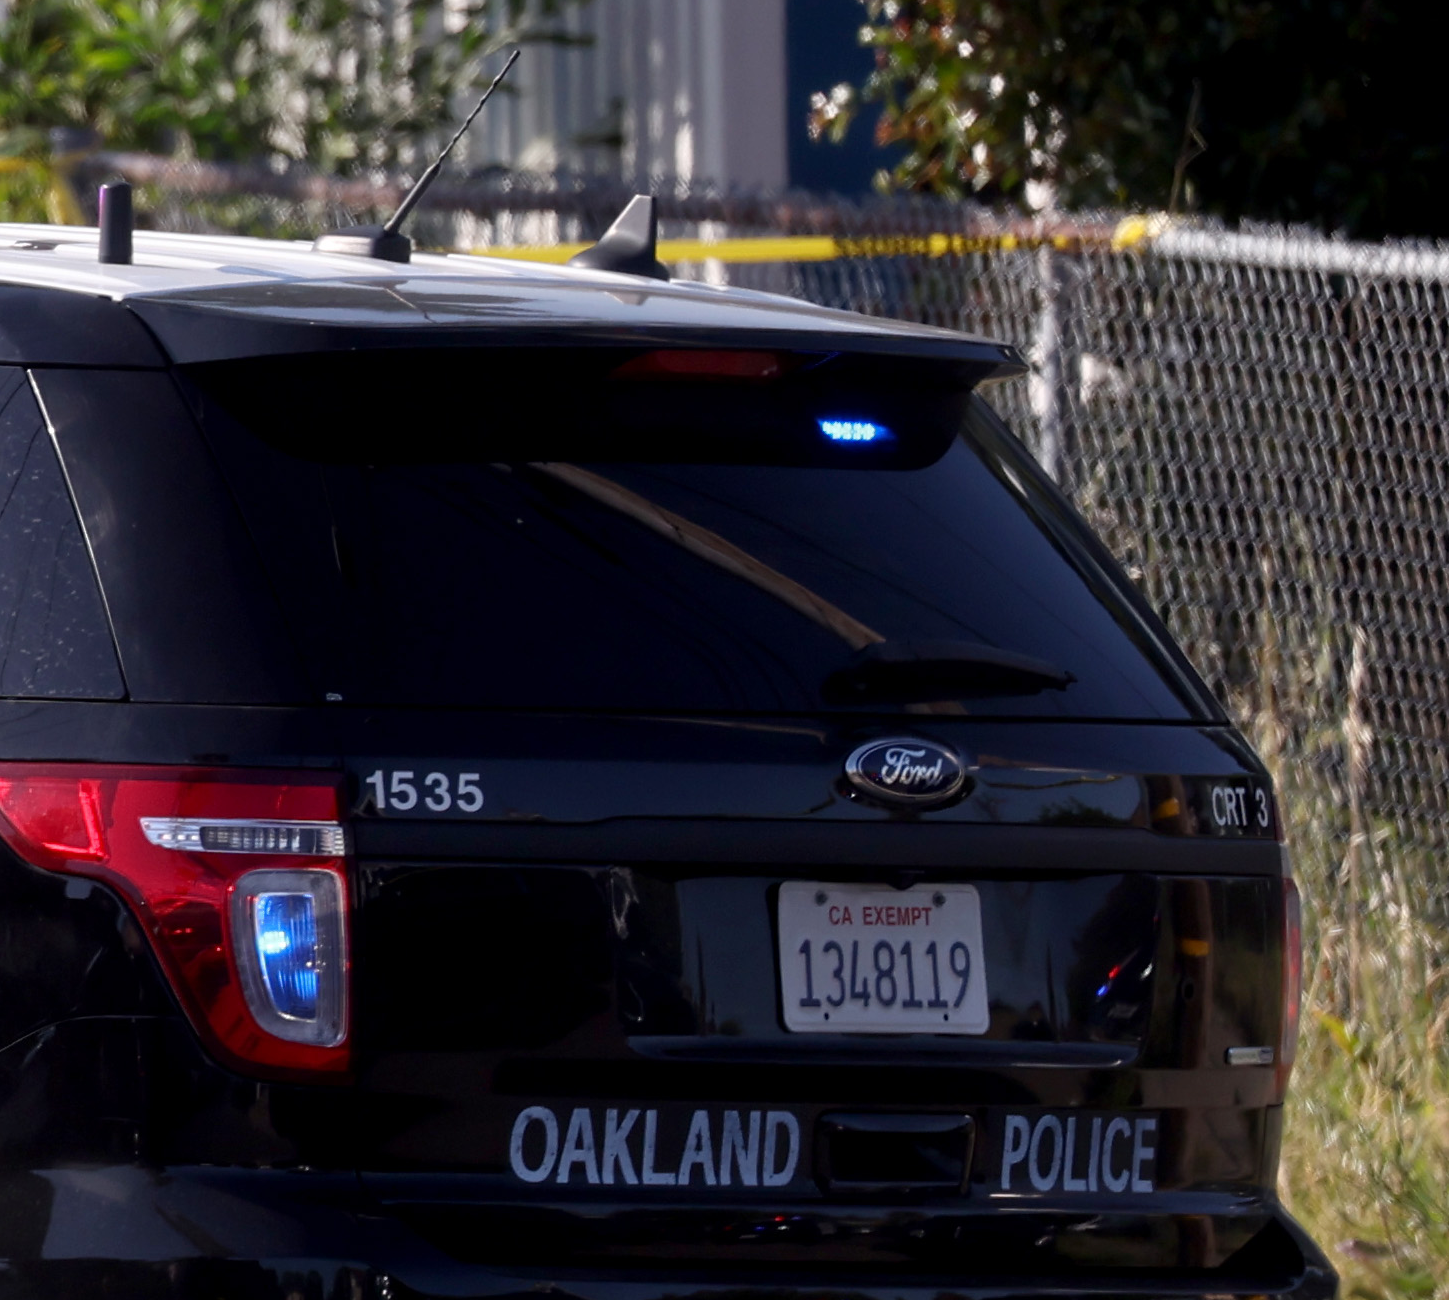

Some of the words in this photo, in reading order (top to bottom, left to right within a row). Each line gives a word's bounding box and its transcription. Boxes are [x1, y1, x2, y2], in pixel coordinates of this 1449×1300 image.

[881, 747, 944, 787] Ford
[366, 770, 484, 813] 1535
[1211, 786, 1248, 827] CRT
[1255, 789, 1269, 828] 3
[828, 905, 853, 926] CA
[862, 905, 932, 927] EXEMPT
[798, 939, 971, 1008] 1348119
[509, 1105, 800, 1186] OAKLAND
[1001, 1113, 1156, 1193] POLICE
